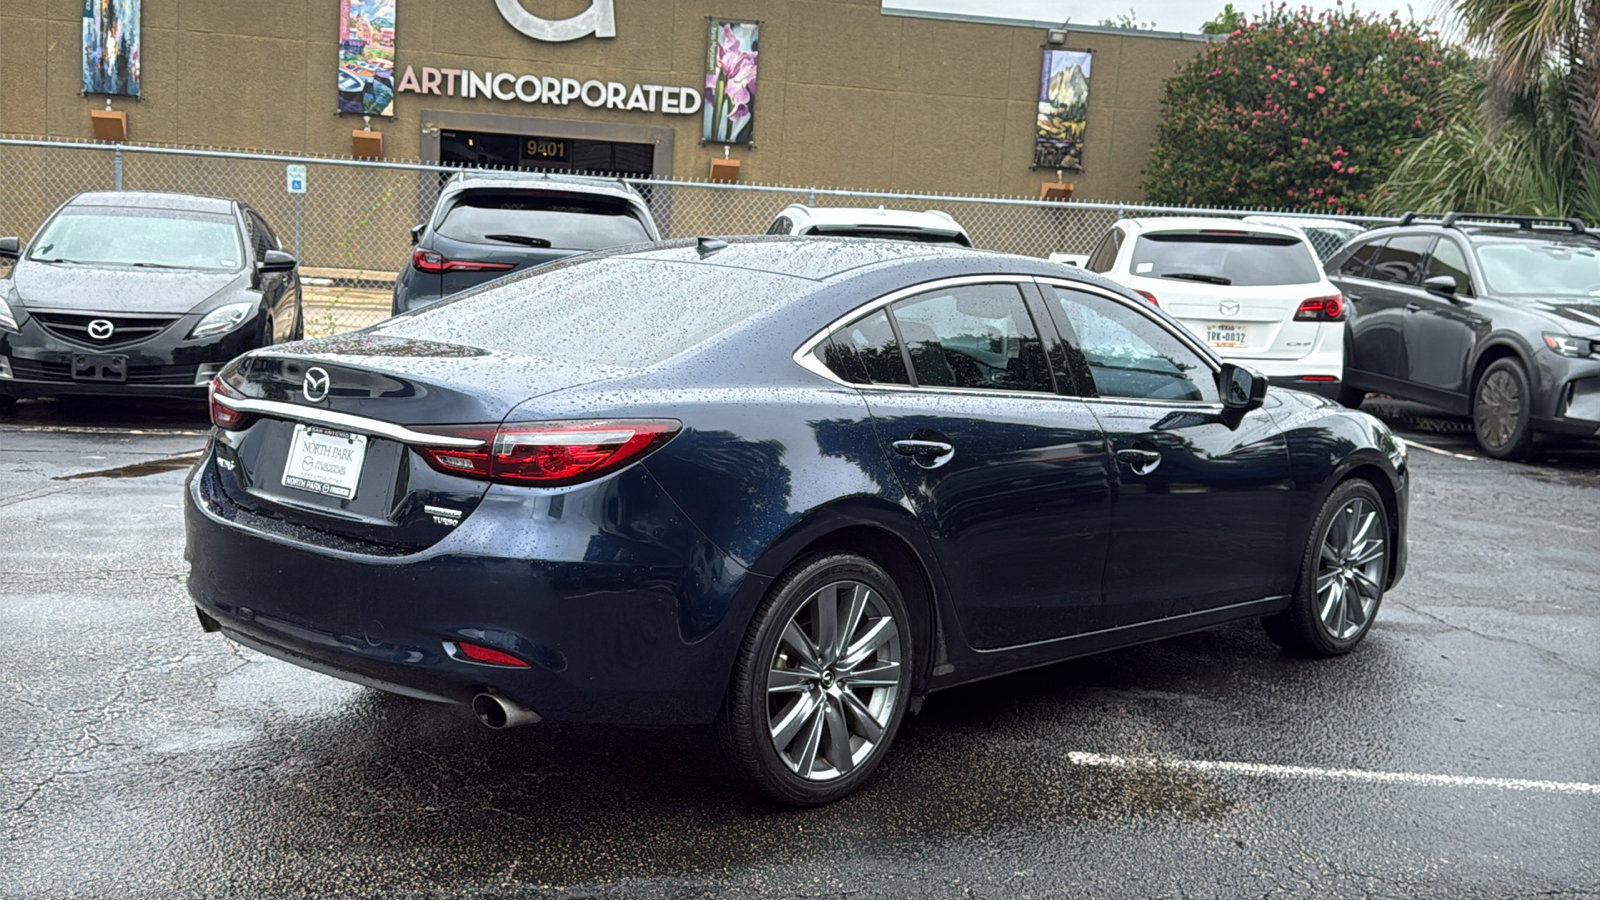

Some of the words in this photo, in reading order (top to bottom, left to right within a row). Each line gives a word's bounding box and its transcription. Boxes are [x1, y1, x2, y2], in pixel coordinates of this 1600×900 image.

[397, 65, 702, 114] ARTINCORPORATED
[527, 140, 564, 157] 9401
[302, 441, 332, 457] NORTH
[332, 445, 355, 462] PARK
[286, 476, 306, 488] NORTH
[306, 480, 322, 492] PARK
[432, 516, 459, 527] TURBO
